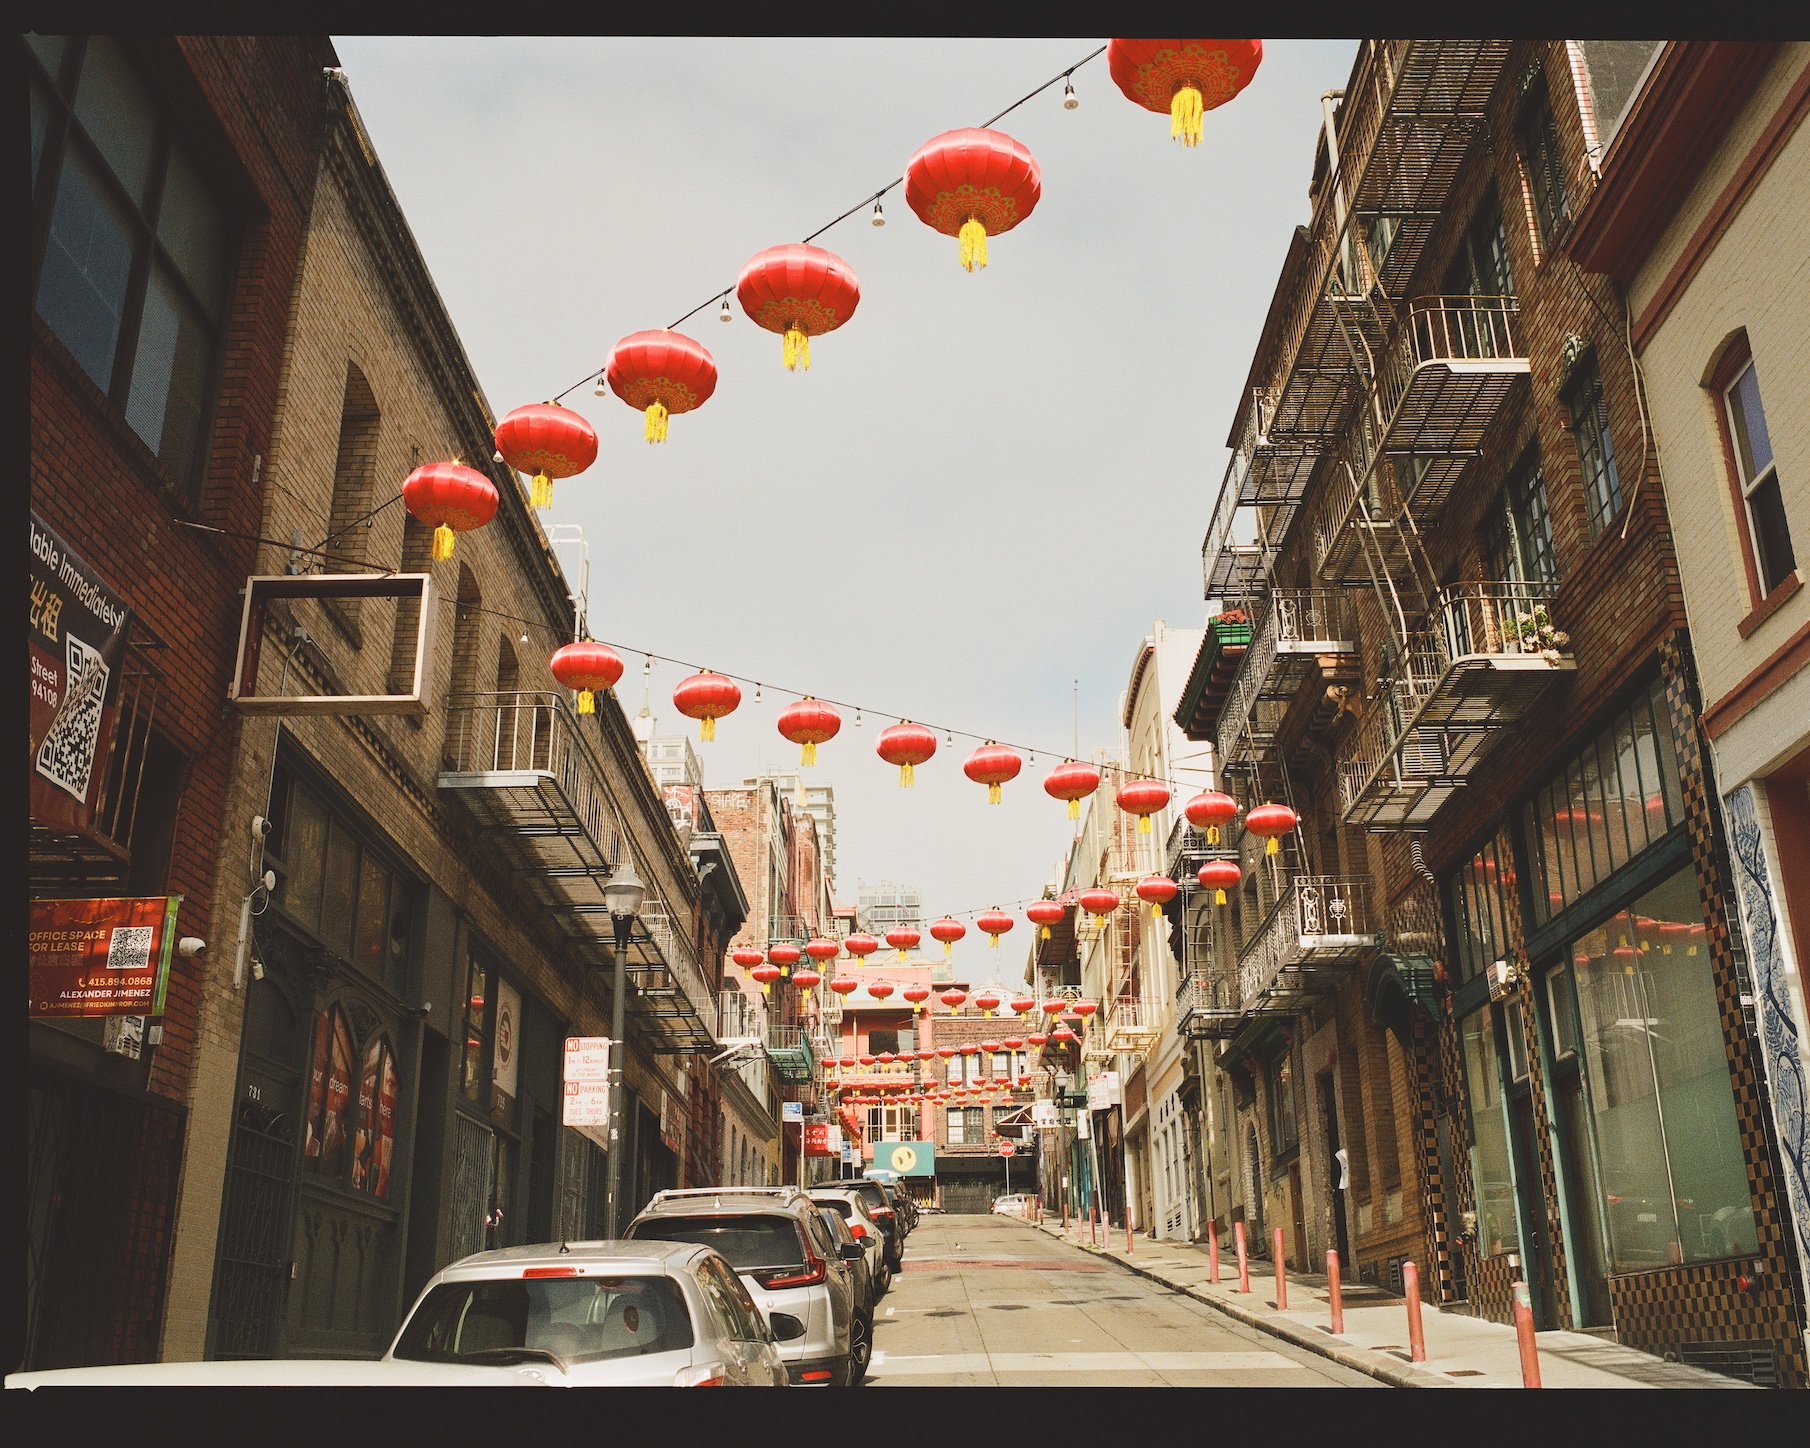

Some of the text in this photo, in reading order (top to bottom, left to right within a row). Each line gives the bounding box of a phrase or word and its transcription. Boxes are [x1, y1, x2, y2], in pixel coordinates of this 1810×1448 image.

[29, 520, 125, 635] lable Immediately!
[29, 574, 63, 643] 出租
[31, 656, 58, 688] Street
[31, 679, 58, 709] 94108
[29, 930, 106, 941] OFFICE SPACE
[50, 942, 85, 952] LEASE
[88, 976, 153, 987] 415.894.0868
[59, 988, 151, 999] ALEXANDER JIMENEZ
[566, 1039, 607, 1051] NO STOPPING
[329, 1074, 349, 1095] dream
[565, 1082, 606, 1095] NO PARKING
[248, 1085, 262, 1101] 731
